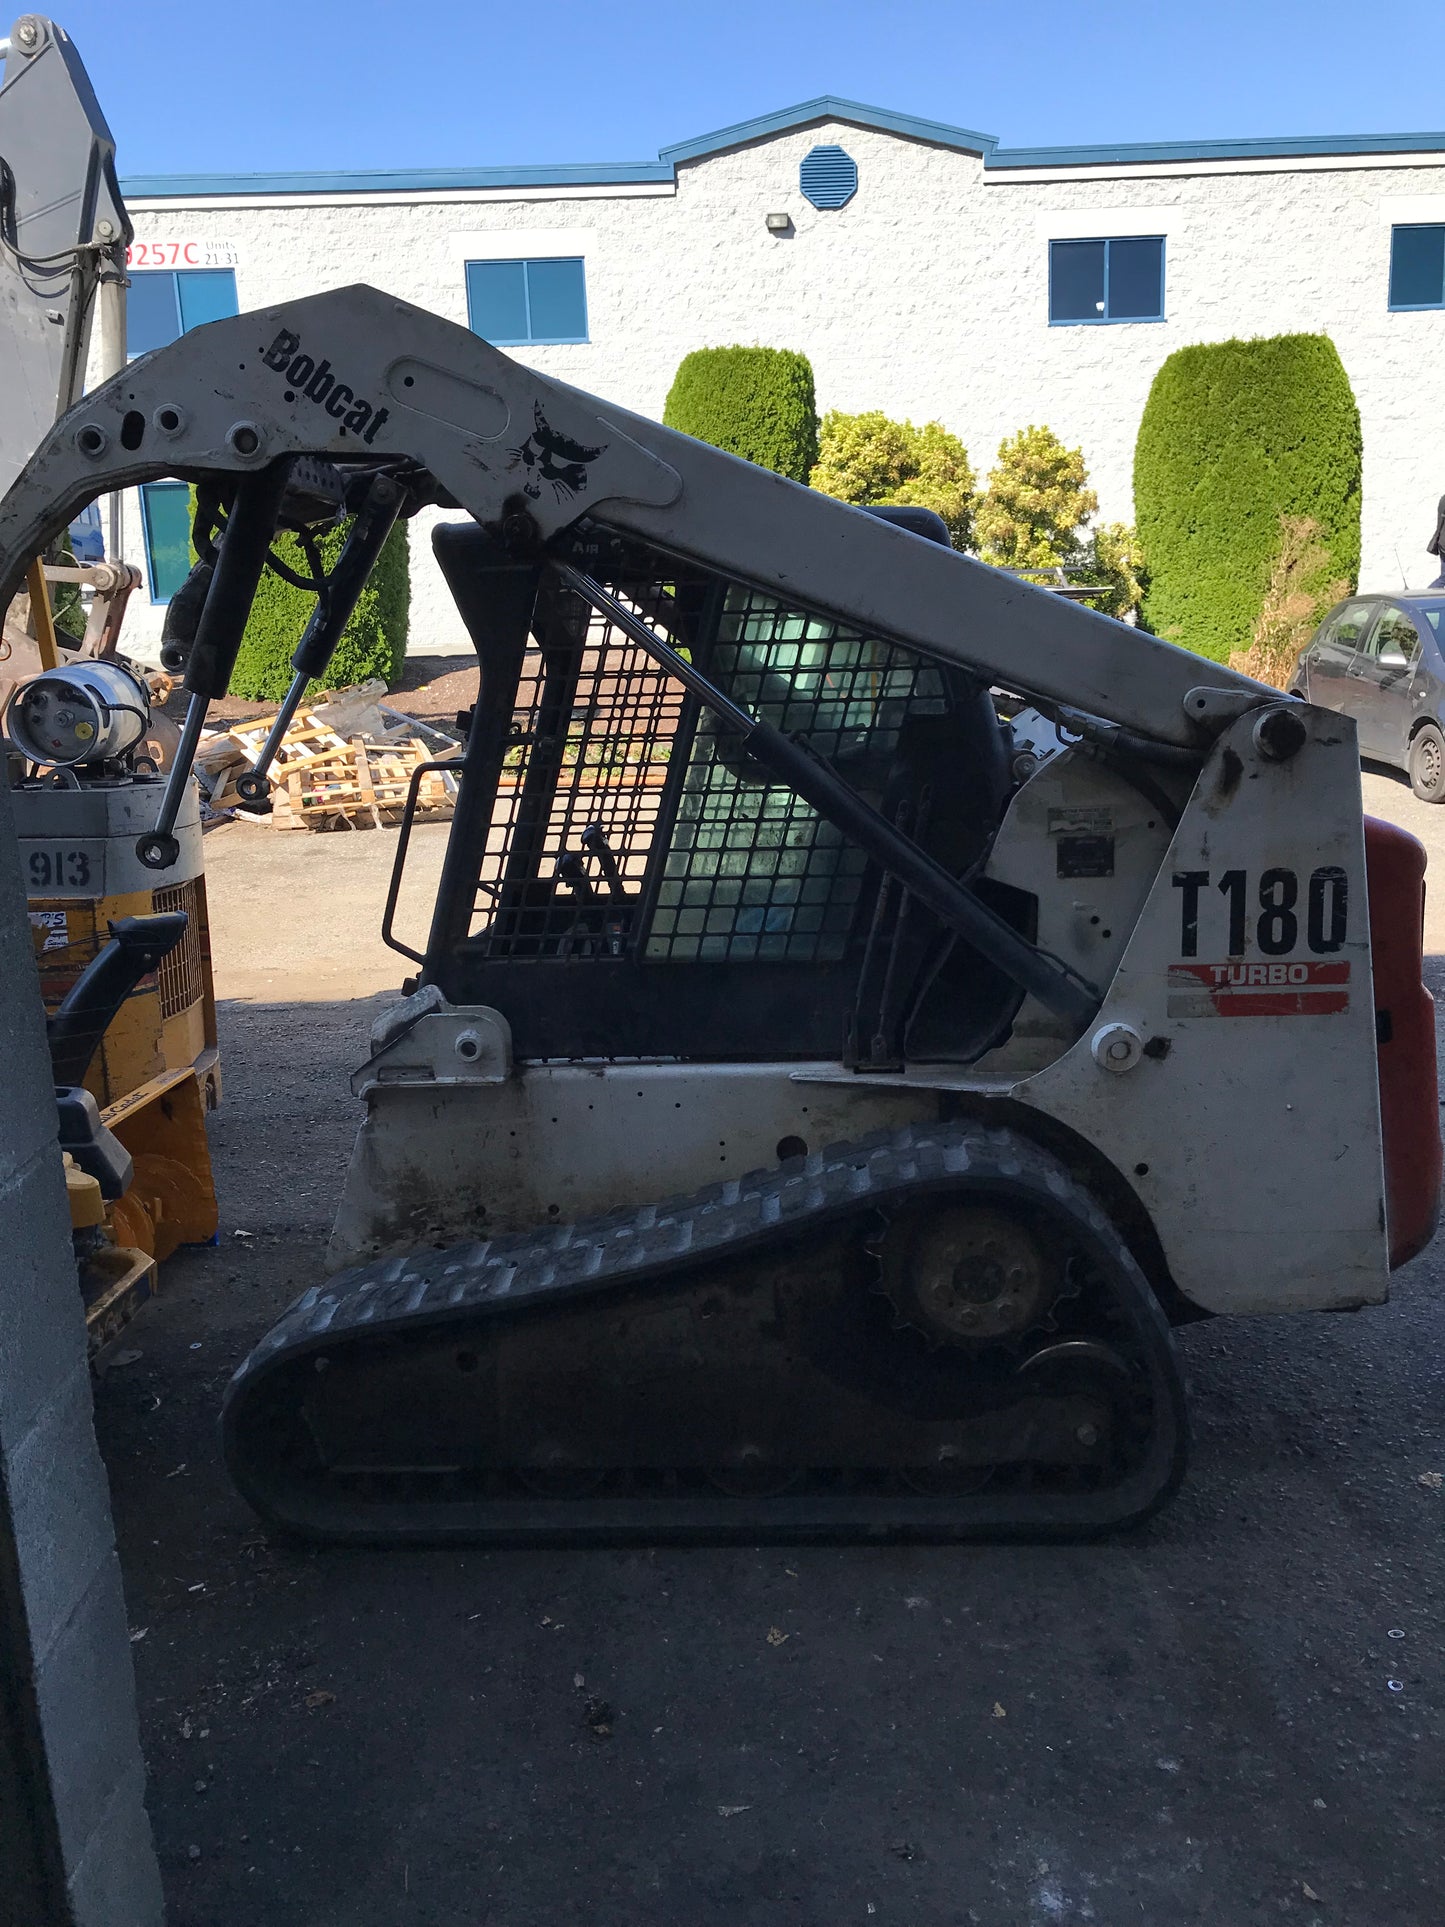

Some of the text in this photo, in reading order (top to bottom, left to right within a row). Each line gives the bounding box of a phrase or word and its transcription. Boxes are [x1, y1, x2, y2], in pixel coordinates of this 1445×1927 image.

[205, 241, 236, 251] Units
[262, 328, 390, 445] Bobcat
[29, 851, 90, 887] 913
[1172, 866, 1348, 957] T180
[1210, 964, 1308, 986] TURBO
